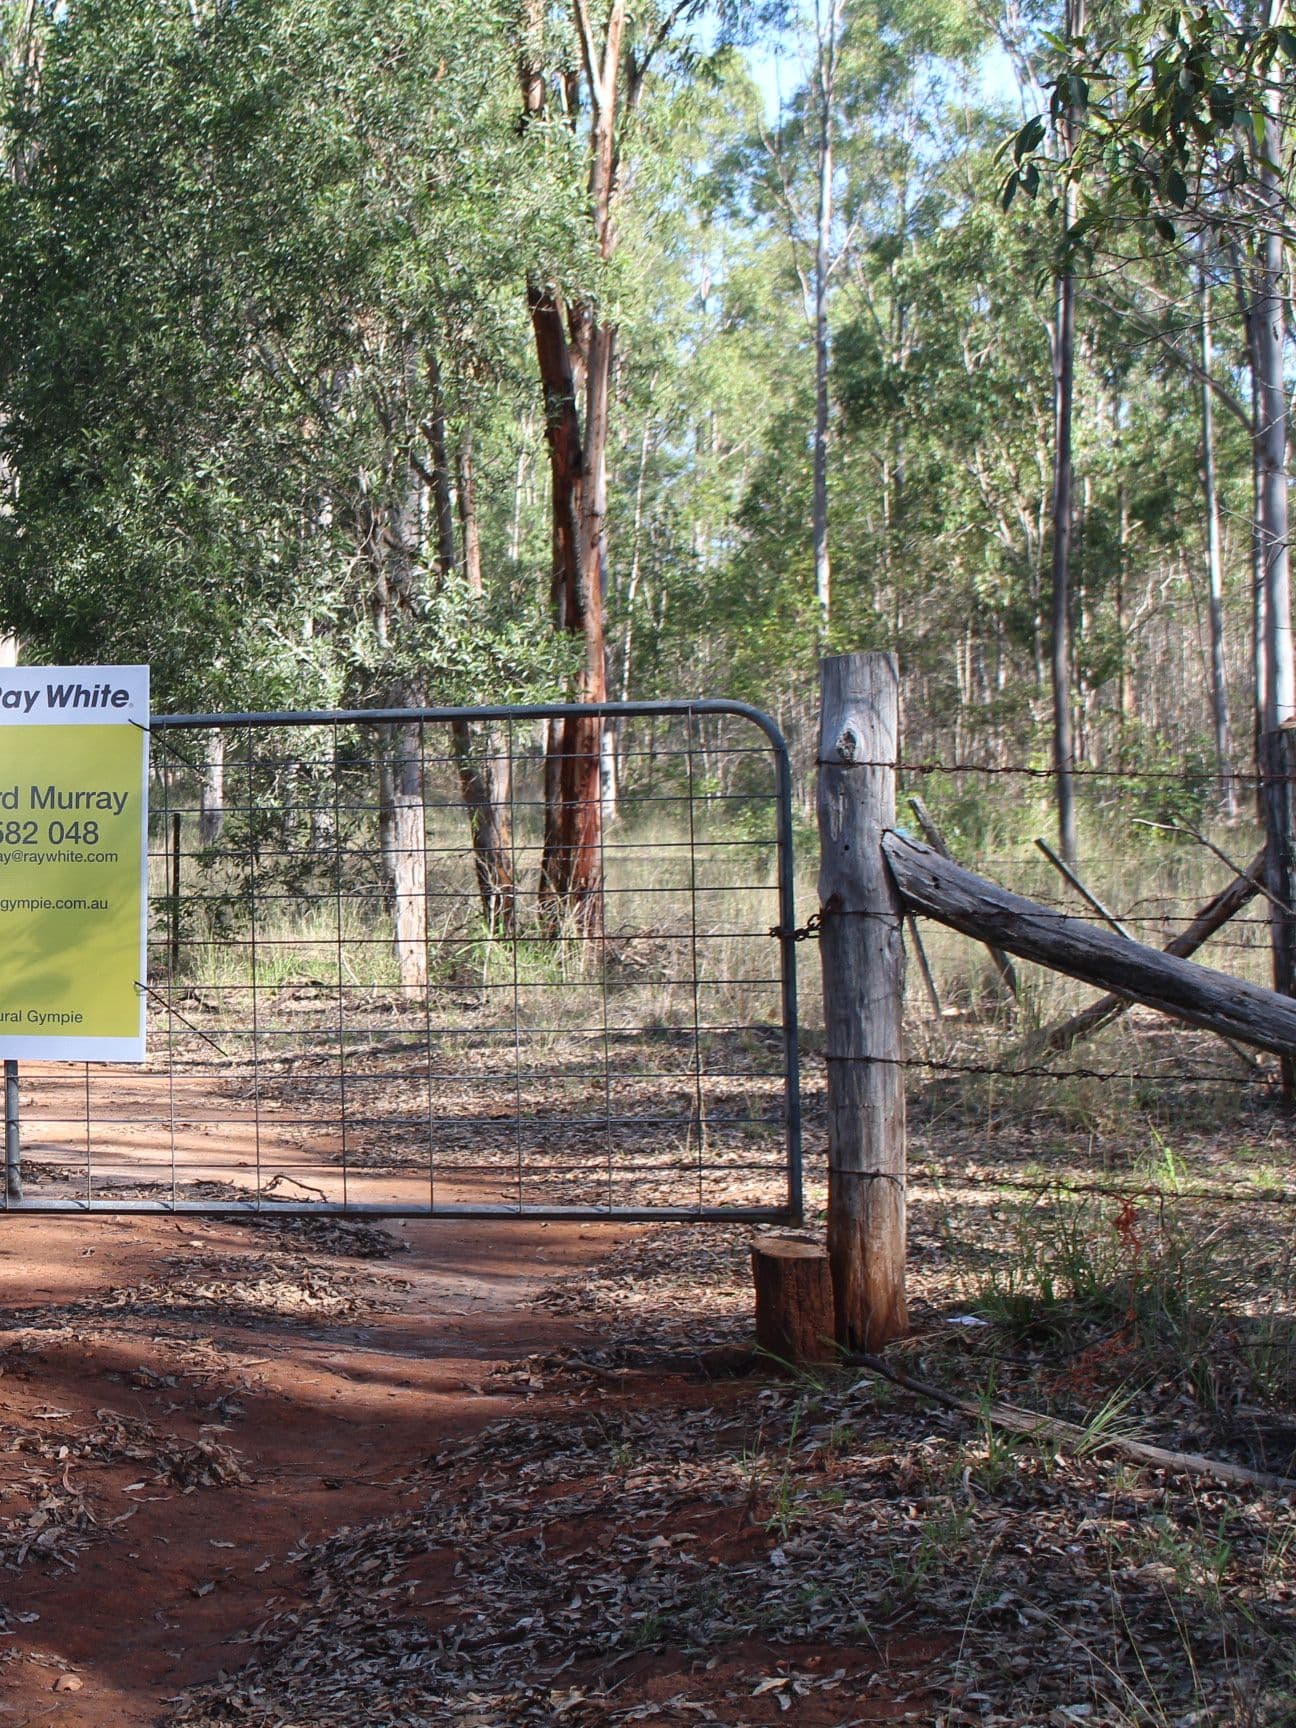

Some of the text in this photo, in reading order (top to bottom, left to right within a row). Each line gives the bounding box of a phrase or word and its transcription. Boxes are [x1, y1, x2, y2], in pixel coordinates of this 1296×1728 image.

[46, 684, 130, 708] White
[30, 785, 129, 816] Murray
[48, 820, 99, 845] 048
[27, 1010, 83, 1025] Gympie
